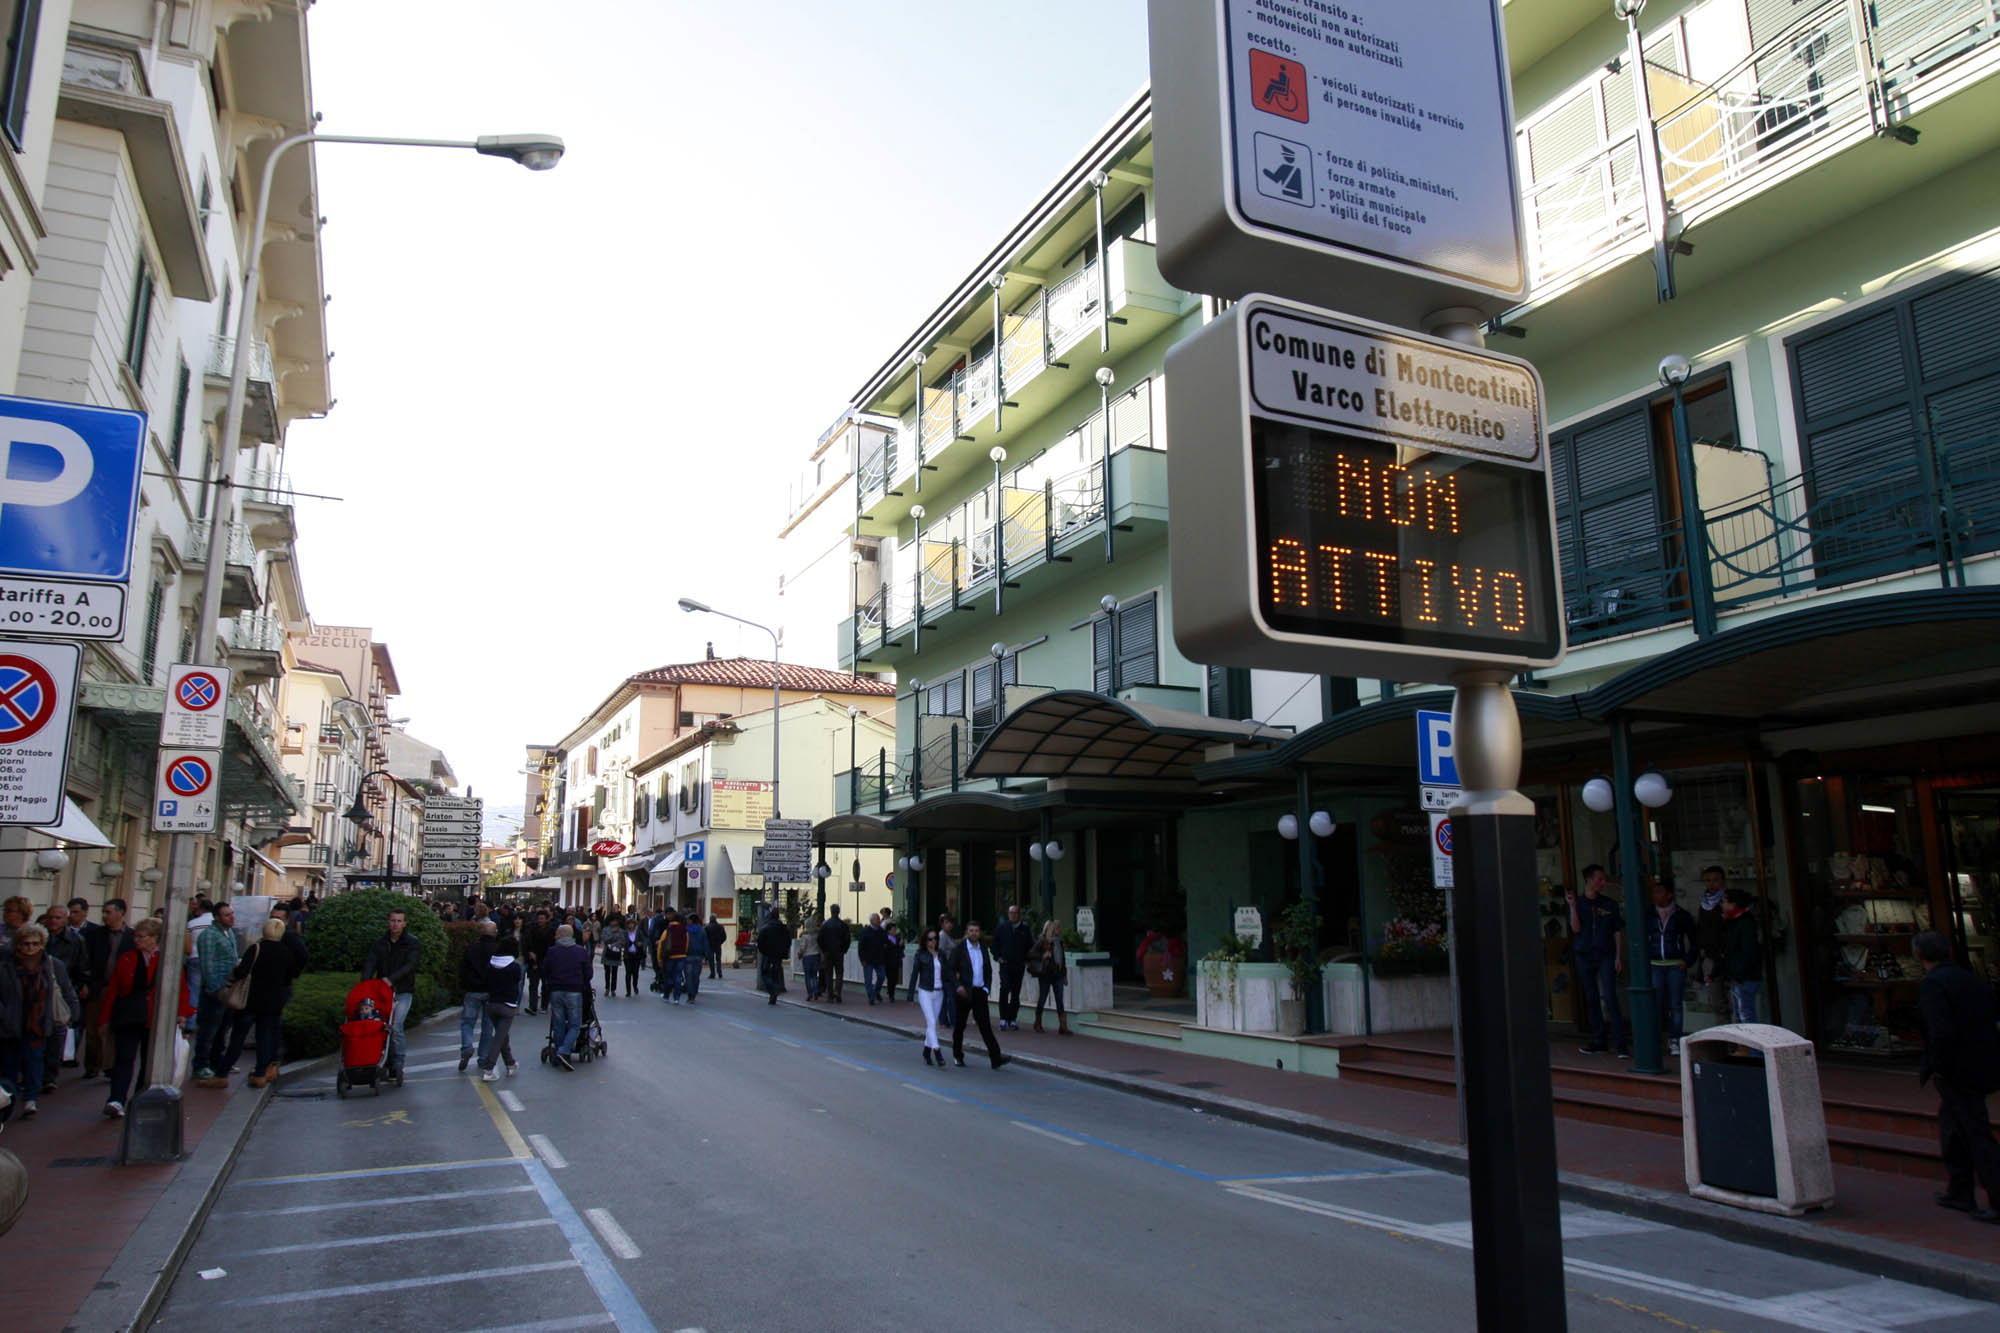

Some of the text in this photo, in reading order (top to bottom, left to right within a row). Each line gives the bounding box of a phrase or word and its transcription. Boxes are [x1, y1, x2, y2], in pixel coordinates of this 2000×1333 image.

[1256, 0, 1400, 53] autoveicoli non autorizzati
[1257, 11, 1322, 41] motoveicoli
[1325, 34, 1345, 48] non
[1348, 42, 1404, 68] autorizzati
[1321, 76, 1358, 96] veicoli
[1361, 89, 1416, 115] autorizzati
[1427, 111, 1465, 131] servizio
[1323, 91, 1422, 132] di persone invalide
[1326, 150, 1354, 169] forze
[1357, 160, 1367, 173] di
[1328, 169, 1396, 199] forze armate
[1329, 186, 1366, 207] polizia
[1369, 198, 1427, 224] municipale
[1330, 202, 1359, 221] vigili
[1362, 211, 1380, 226] del
[1382, 217, 1412, 235] fuoco
[1255, 320, 1529, 409] Comune di Montecatini
[1292, 369, 1506, 441] Varco Elettronico
[1336, 453, 1460, 534] NON
[0, 587, 90, 606] tariffa A
[1271, 537, 1526, 634] ATTIVO
[50, 610, 113, 628] 20.00
[17, 748, 53, 757] Ottobre
[14, 795, 48, 804] Maggio
[178, 820, 208, 828] minuti
[689, 842, 701, 859] P
